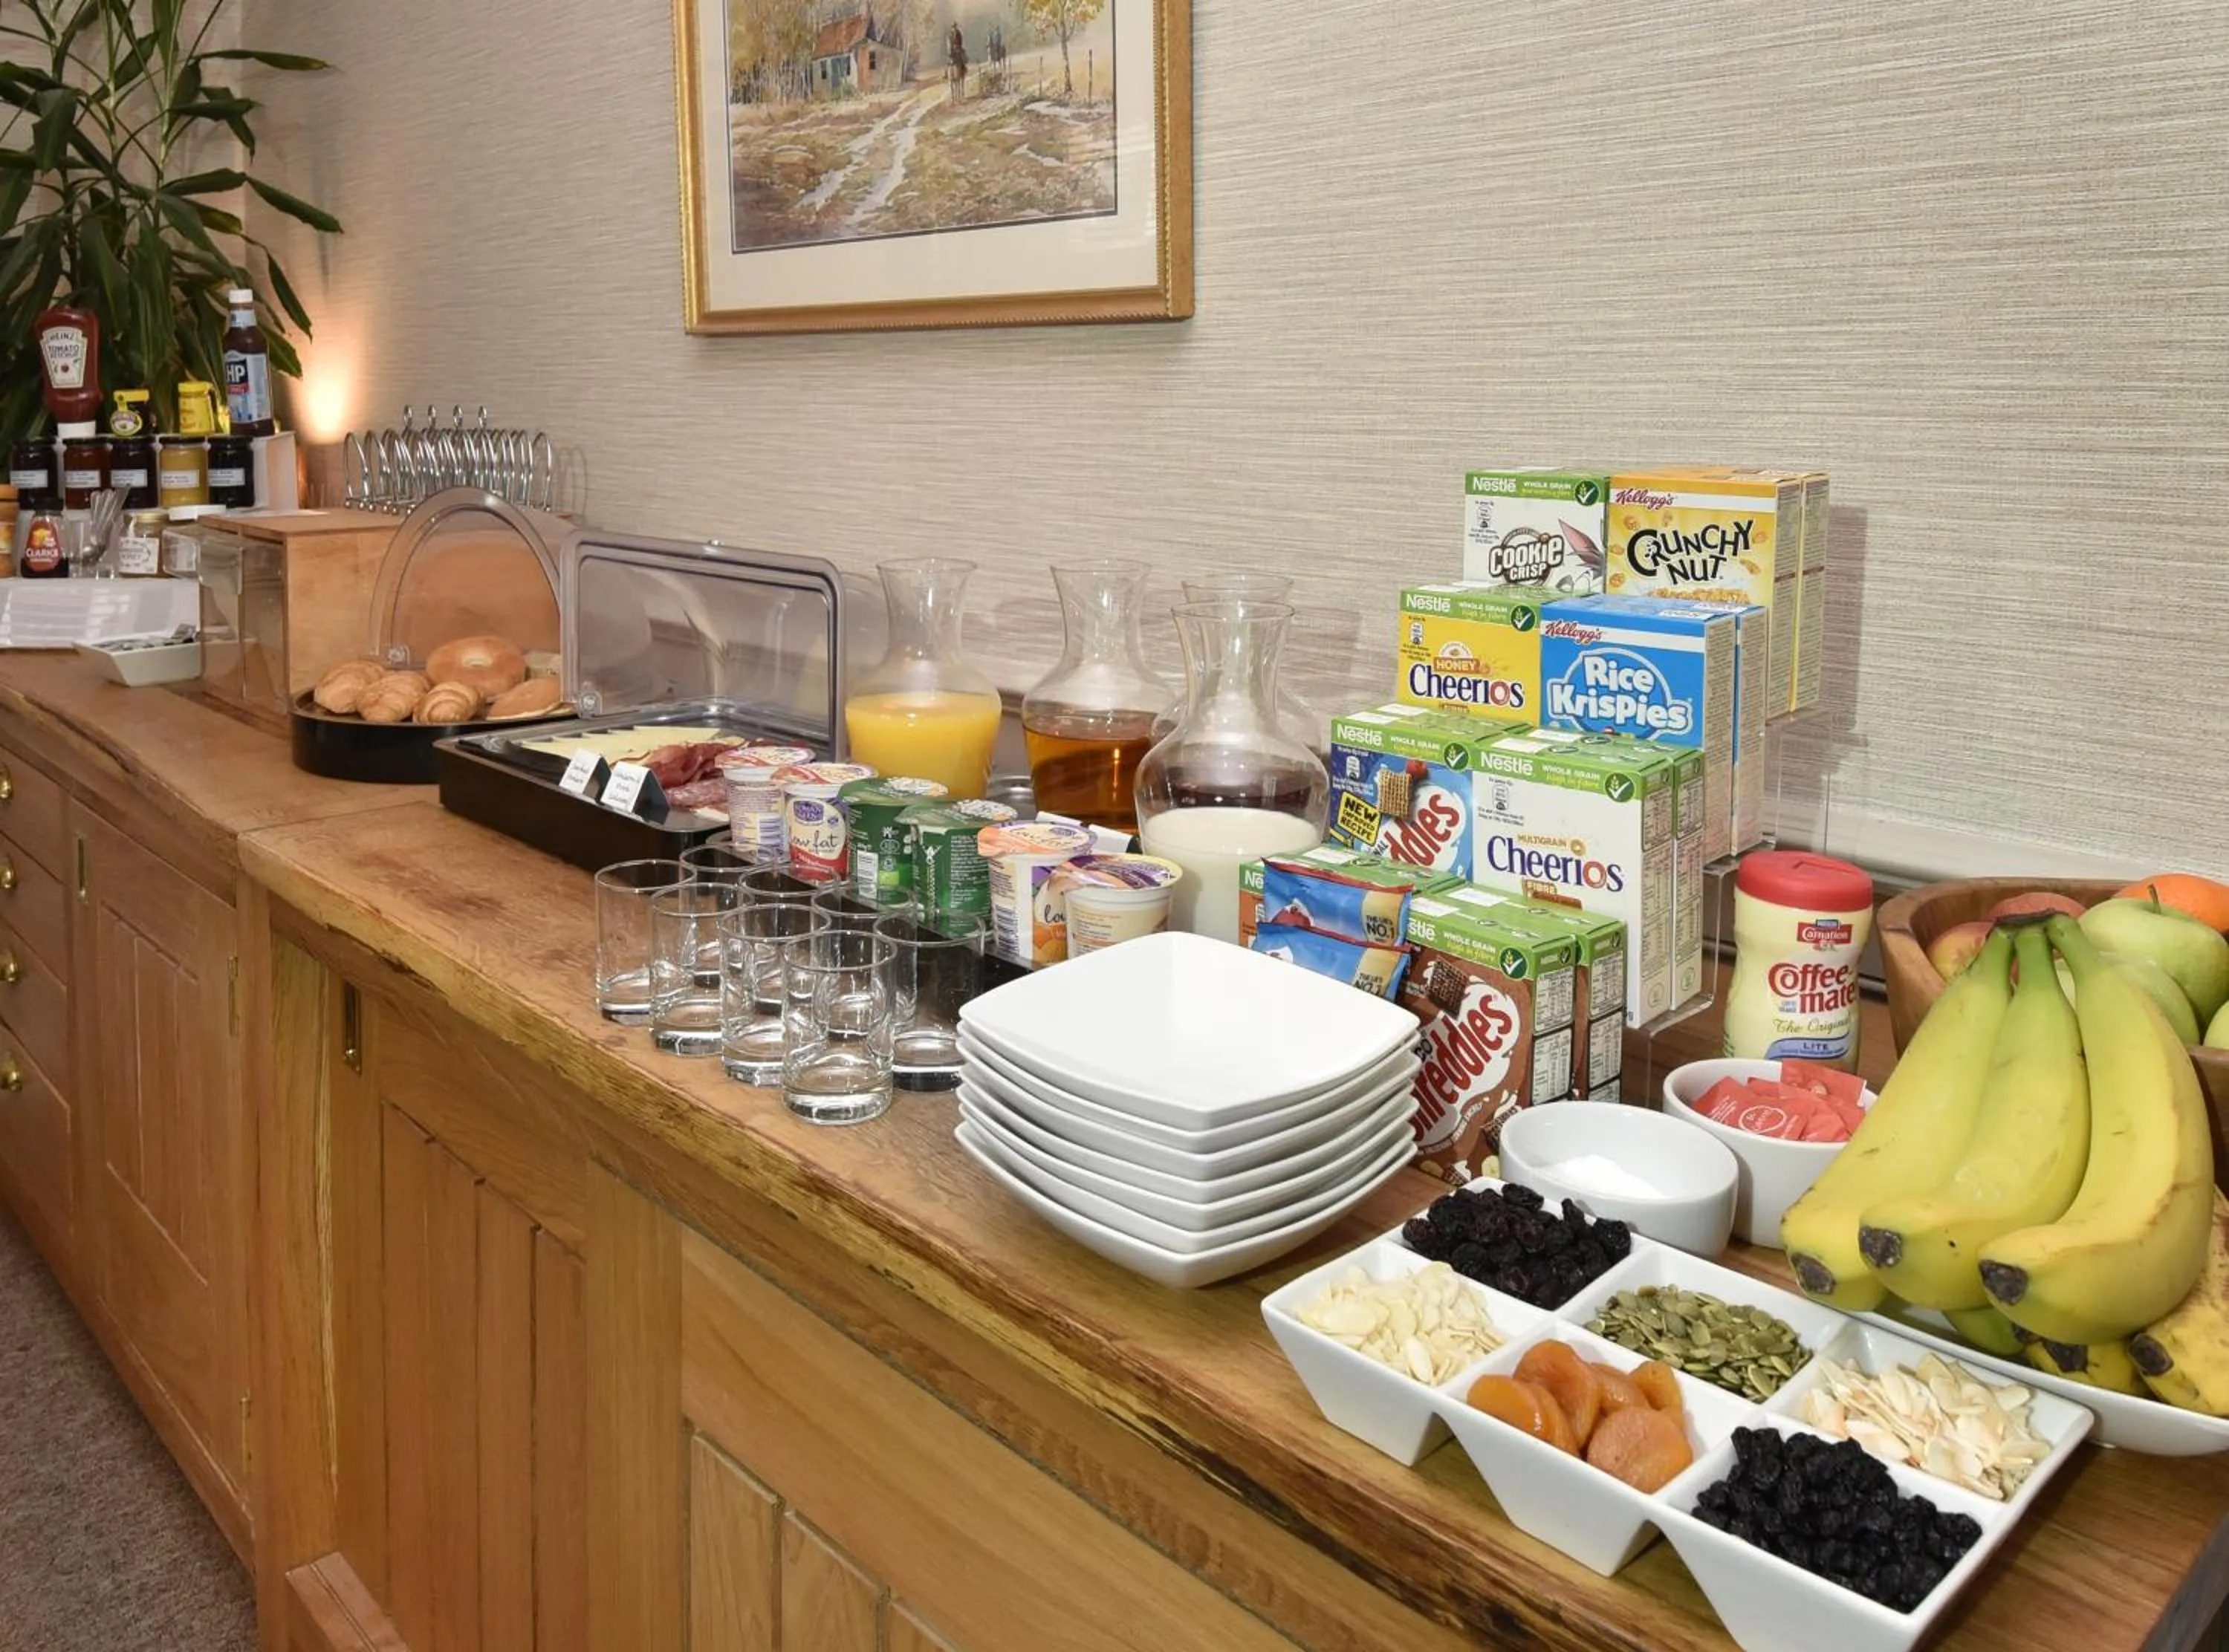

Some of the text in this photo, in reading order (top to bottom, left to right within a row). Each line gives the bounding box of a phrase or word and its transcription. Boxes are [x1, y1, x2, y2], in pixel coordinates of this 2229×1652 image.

[48, 344, 80, 353] TOMATO
[227, 365, 245, 383] HP
[1616, 488, 1675, 510] Kellogg's
[1627, 520, 1753, 576] CRUNCHY
[1509, 563, 1547, 581] CRISP
[1667, 555, 1727, 585] NUT
[1459, 602, 1484, 611] WHOLE
[1545, 621, 1602, 643] Kellogg's
[1436, 660, 1476, 671] HONEY
[1584, 657, 1654, 692] Rice
[1409, 663, 1523, 707] Cheerios
[1552, 684, 1687, 729] Krispies
[1391, 735, 1415, 746] WHOLE
[1418, 741, 1440, 749] GRAIN
[1542, 764, 1571, 775] WHOLE
[1574, 770, 1600, 779] GRAIN
[1344, 796, 1378, 822] NEW
[1340, 818, 1372, 839] RECIPE
[814, 830, 839, 853] fat
[1517, 833, 1567, 848] MULTIGRAIN
[1487, 835, 1623, 892] Cheerios
[1366, 923, 1395, 940] NO.1
[1802, 927, 1848, 941] Carnation
[1444, 931, 1470, 945] WHOLE
[1472, 939, 1496, 954] GRAIN
[1800, 983, 1855, 1013] mate
[1773, 1018, 1801, 1033] The
[1803, 1042, 1829, 1050] LITE
